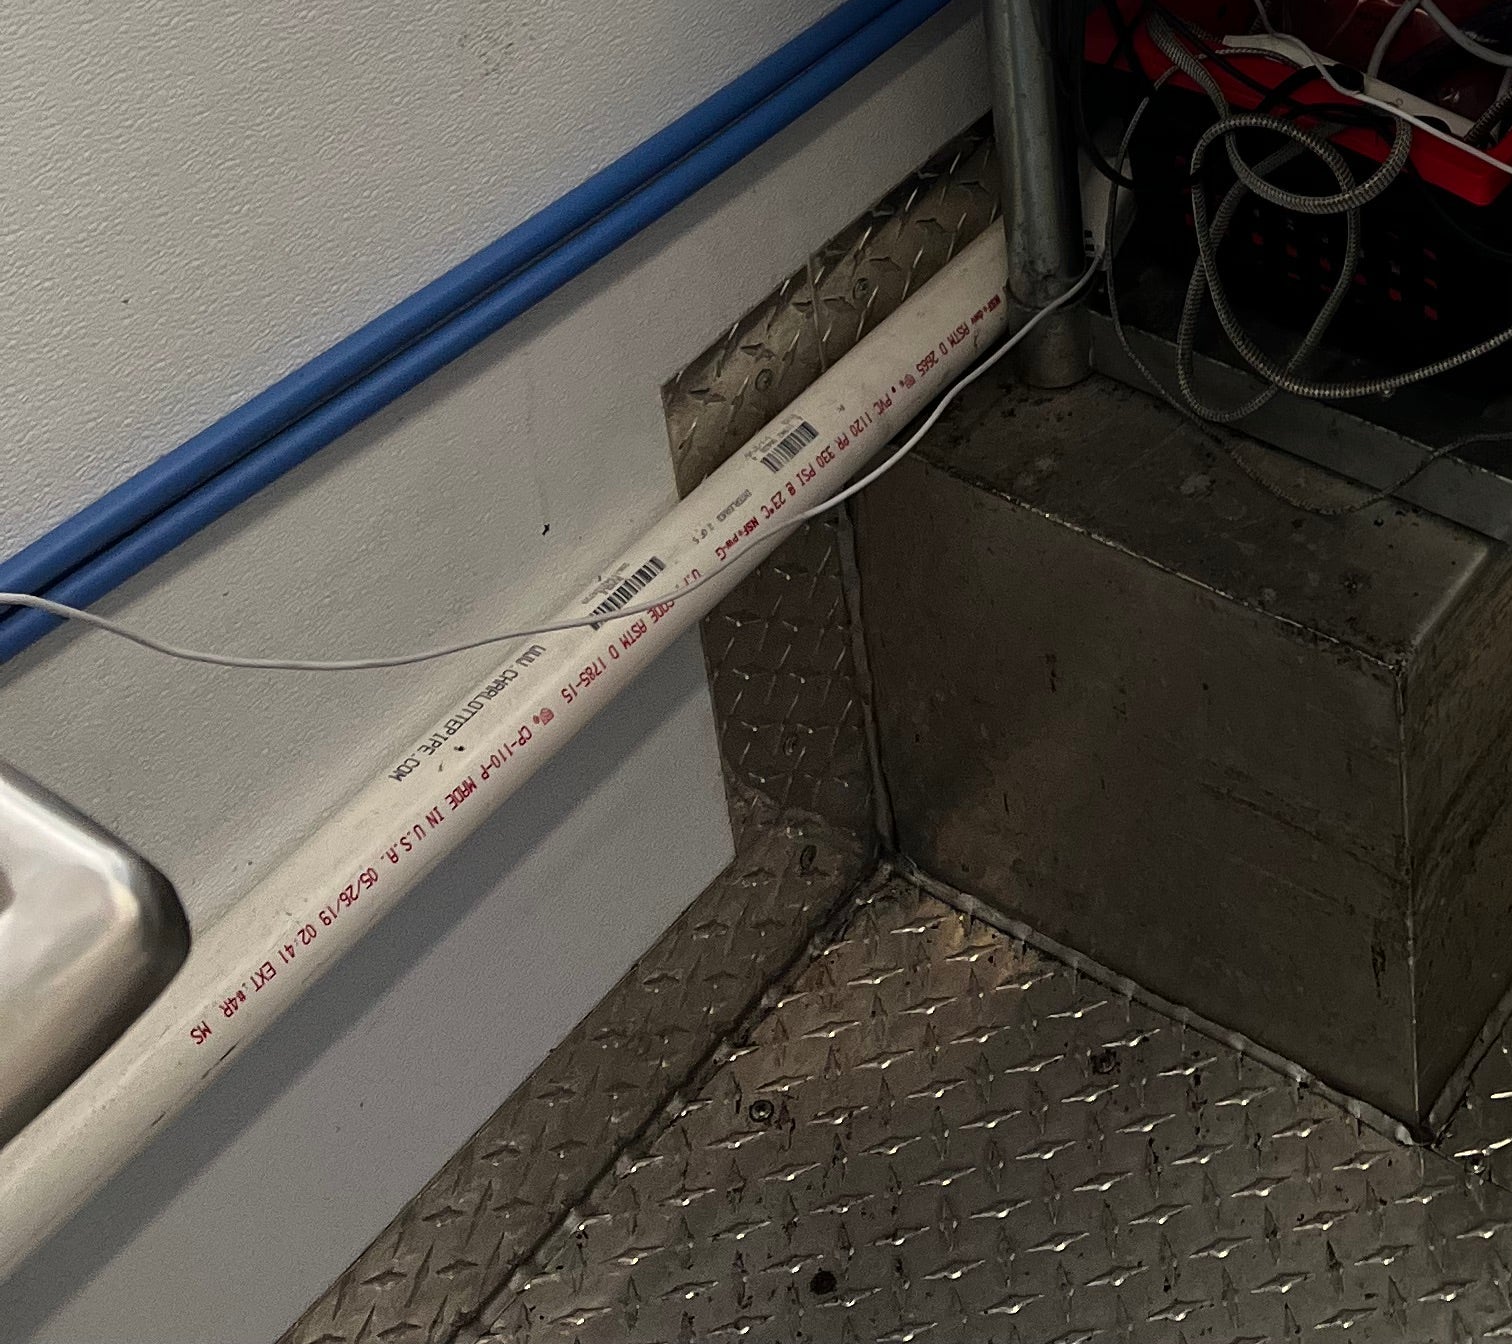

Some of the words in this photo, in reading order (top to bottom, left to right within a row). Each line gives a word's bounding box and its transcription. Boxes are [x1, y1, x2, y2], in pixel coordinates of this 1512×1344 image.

[948, 322, 970, 347] ASTM
[916, 351, 938, 376] 2665
[875, 394, 893, 415] PVC
[850, 412, 873, 437] 1120
[837, 433, 850, 450] PR
[816, 445, 836, 467] 330
[796, 464, 817, 486] PSI
[761, 492, 786, 518] 23°C
[620, 619, 647, 649] ASTM
[608, 645, 619, 659] D
[561, 658, 607, 703] 1785-15
[388, 645, 546, 782] WWW.CHARLOTTEPIPE.COM
[481, 725, 532, 780] CP-110-P
[446, 776, 478, 810] MADE
[426, 806, 444, 828] IN
[380, 824, 426, 864] U.S.A.
[319, 868, 378, 926] 05/26/19
[190, 1021, 213, 1046] MS
